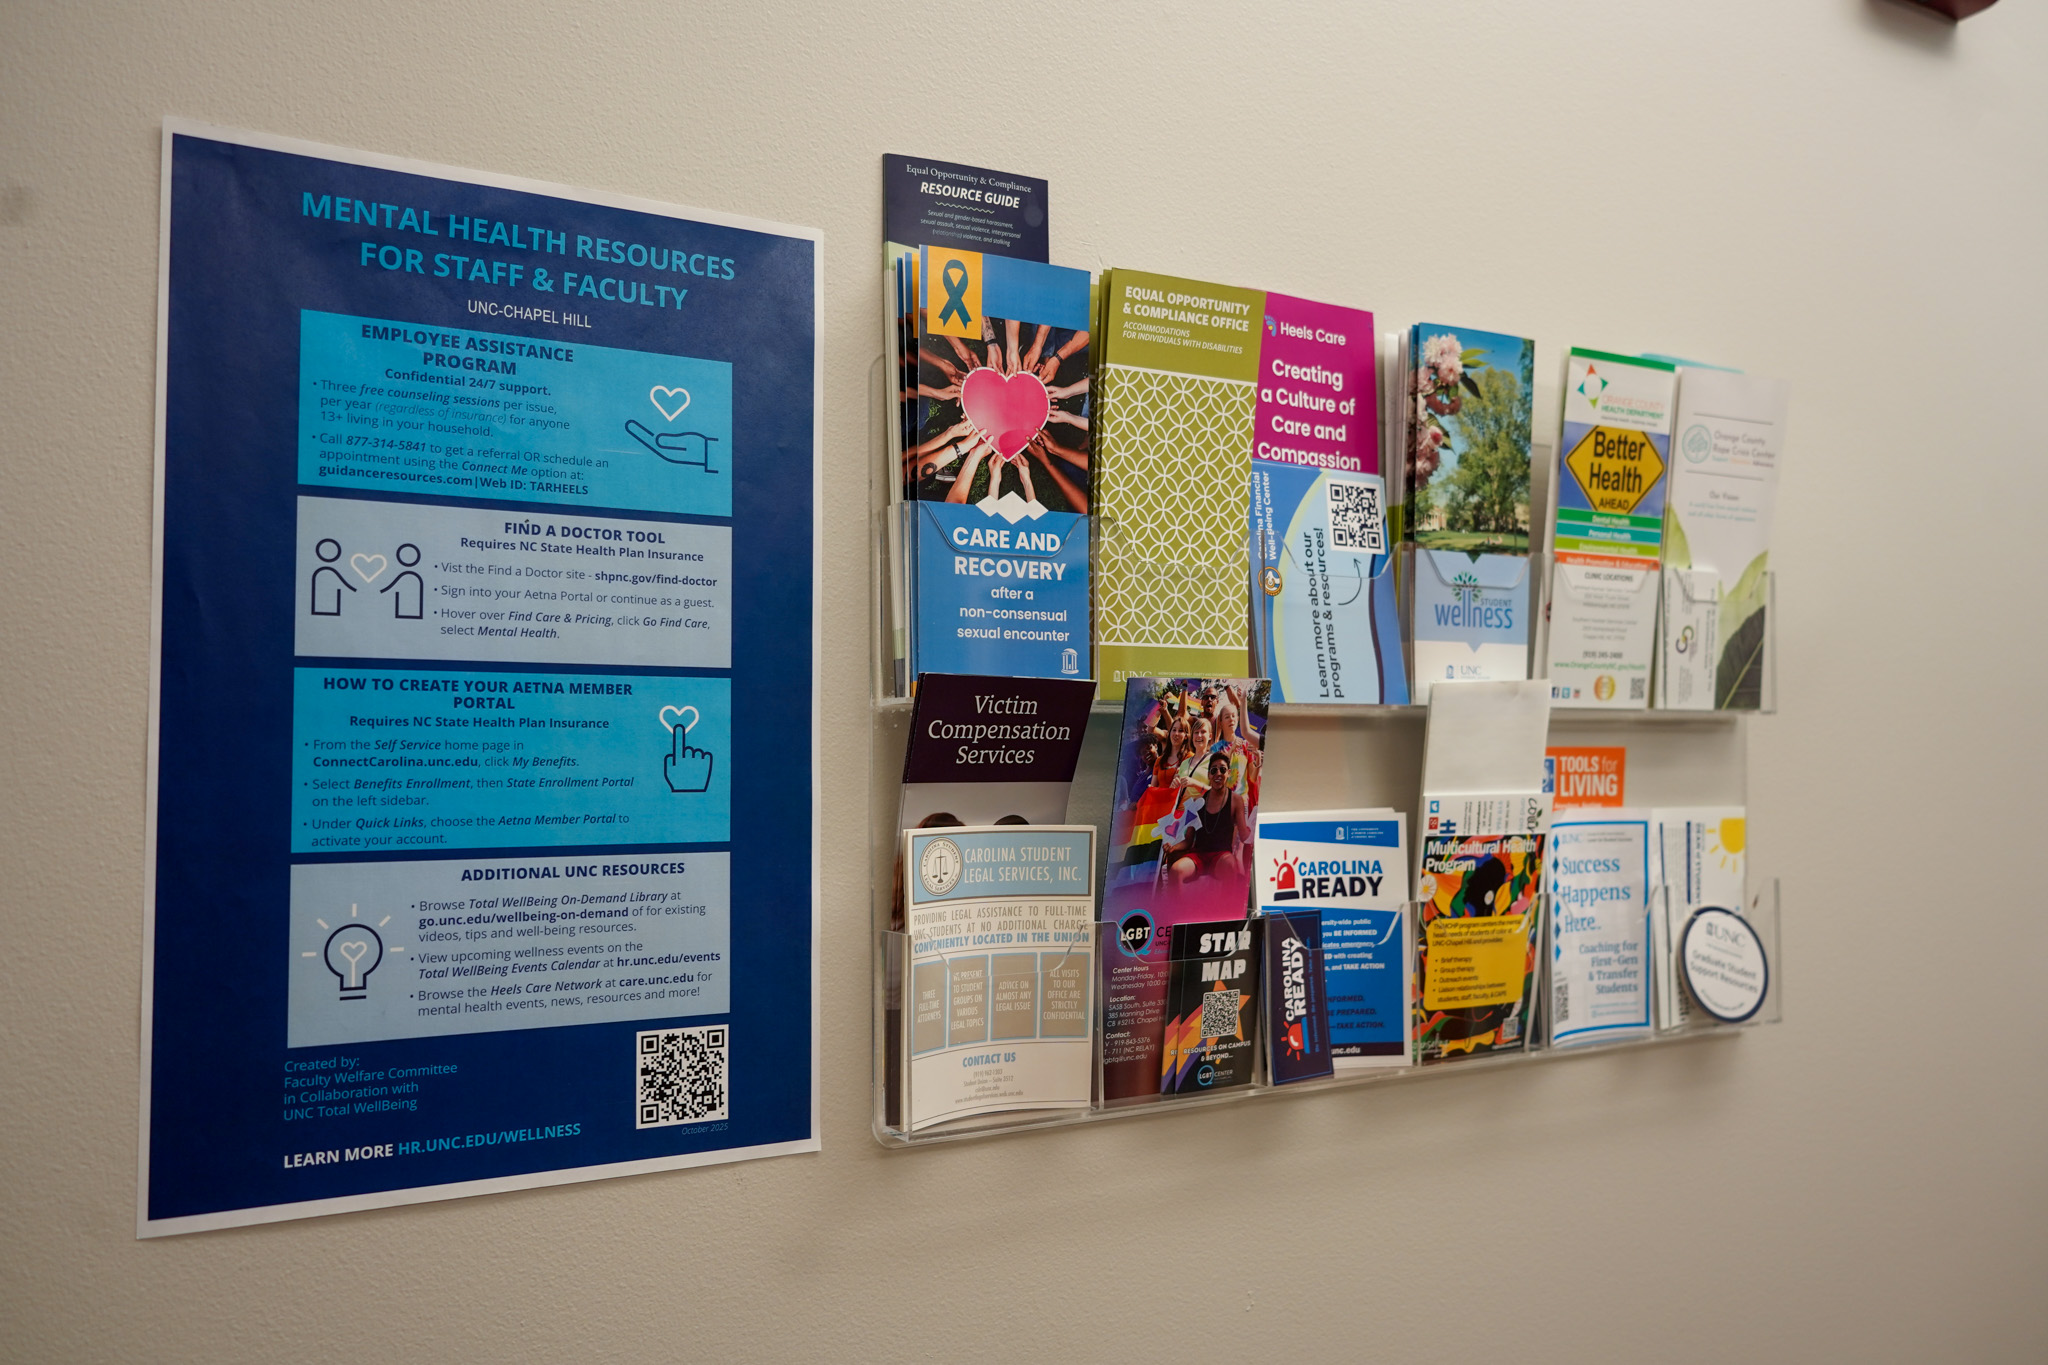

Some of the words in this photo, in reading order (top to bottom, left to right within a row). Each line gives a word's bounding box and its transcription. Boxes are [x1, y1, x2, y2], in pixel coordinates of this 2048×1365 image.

[907, 164, 928, 175] Equal
[930, 168, 978, 185] Opportunity
[989, 178, 1031, 193] Compliance
[921, 182, 982, 201] RESOURCE
[985, 192, 1020, 208] GUIDE
[954, 214, 985, 224] gender-based
[986, 219, 1013, 229] harassment,
[302, 191, 439, 236] MENTAL
[448, 214, 566, 255] HEALTH
[577, 234, 735, 281] RESOURCES
[360, 241, 425, 275] FOR
[434, 252, 524, 288] STAFF
[532, 268, 554, 292] &
[563, 272, 688, 310] FACULTY
[1125, 286, 1165, 303] EQUAL
[1167, 292, 1250, 315] OPPORTUNITY
[468, 300, 559, 324] UNC-CHAPEL
[563, 313, 591, 328] HILL
[1123, 303, 1131, 314] &
[1134, 304, 1209, 325] COMPLIANCE
[1211, 316, 1249, 332] OFFICE
[1123, 321, 1190, 338] ACCOMMODATIONS
[1280, 322, 1313, 341] Heels
[1315, 329, 1346, 346] Care
[361, 324, 460, 349] EMPLOYEE
[465, 336, 574, 363] ASSISTANCE
[1122, 330, 1136, 338] FOR
[1137, 332, 1181, 346] INDIVIDUALS
[1183, 338, 1201, 348] WITH
[1202, 341, 1242, 354] DISABILITIES
[423, 352, 517, 375] PROGRAM
[385, 368, 465, 387] Confidential
[468, 375, 497, 390] 24/7
[499, 381, 551, 397] support.
[1272, 360, 1343, 392] Creating
[1261, 390, 1272, 402] a
[1276, 388, 1335, 413] Culture
[1339, 398, 1355, 415] of
[1271, 416, 1311, 437] Care
[1314, 421, 1346, 442] and
[320, 433, 342, 444] Call
[346, 435, 426, 452] 877-314-5841
[430, 443, 442, 453] to
[445, 444, 464, 457] get
[467, 447, 474, 456] a
[477, 447, 520, 460] referral
[524, 451, 541, 462] OR
[543, 452, 593, 467] schedule
[596, 458, 608, 468] an
[1257, 442, 1361, 471] Compassion
[1594, 431, 1646, 461] Better
[510, 479, 527, 490] ID:
[530, 481, 588, 495] TARHEELS
[1262, 471, 1271, 505] Center
[1589, 462, 1642, 494] Health
[1253, 472, 1262, 516] Financial
[1599, 498, 1629, 511] AHEAD
[504, 521, 541, 537] FIND
[546, 526, 557, 538] A
[561, 526, 622, 542] DOCTOR
[627, 530, 666, 544] TOOL
[953, 527, 1010, 548] CARE
[1015, 532, 1061, 551] AND
[1265, 507, 1277, 560] Well-Being
[1303, 532, 1312, 557] our
[955, 556, 1066, 581] RECOVERY
[1313, 528, 1331, 606] resources!
[595, 571, 717, 587] shpnc.gov/find-doctor
[1304, 561, 1319, 606] about
[991, 587, 1022, 599] after
[1025, 591, 1034, 600] a
[1480, 598, 1512, 606] STUDENT
[960, 607, 1067, 622] non-consensual
[1323, 610, 1332, 620] &
[1434, 590, 1512, 628] wellness
[957, 627, 1000, 639] sexual
[1004, 630, 1069, 642] encounter
[1311, 610, 1324, 650] more
[1323, 624, 1344, 698] programs
[1460, 665, 1482, 675] UNC
[323, 677, 366, 691] HOW
[371, 678, 394, 692] TO
[399, 678, 459, 692] CREATE
[464, 680, 508, 693] YOUR
[512, 681, 564, 695] AETNA
[568, 682, 633, 695] MEMBER
[1318, 654, 1329, 698] Learn
[453, 697, 515, 710] PORTAL
[975, 695, 1038, 715] Victim
[928, 719, 1070, 744] Compensation
[956, 745, 1035, 764] Services
[1560, 756, 1599, 772] TOOLS
[1602, 756, 1618, 771] for
[1560, 774, 1618, 797] LIVING
[965, 848, 1015, 863] CAROLINA
[1020, 847, 1071, 862] STUDENT
[1427, 840, 1500, 855] Multicultural
[1502, 840, 1536, 853] Health
[461, 866, 560, 882] ADDITIONAL
[565, 864, 597, 878] UNC
[602, 861, 685, 877] RESOURCES
[964, 867, 994, 883] LEGAL
[999, 867, 1053, 884] SERVICES,
[1059, 867, 1081, 880] INC.
[1298, 860, 1383, 876] CAROLINA
[1425, 858, 1476, 874] Program
[1562, 857, 1620, 875] Success
[1302, 876, 1383, 899] READY
[1562, 886, 1631, 907] Happens
[1121, 927, 1151, 941] LGBT
[1199, 931, 1251, 953] STAR
[1715, 924, 1746, 947] UNC
[1579, 942, 1620, 954] Coaching
[1622, 941, 1639, 952] for
[1201, 959, 1246, 982] MAP
[1591, 955, 1638, 967] First-Gen
[1282, 938, 1294, 1021] CAROLINA
[1290, 938, 1306, 1016] READY
[1596, 970, 1638, 981] Transfer
[1596, 982, 1638, 994] Students
[1184, 1045, 1217, 1054] RESOURCES
[1228, 1040, 1251, 1048] CAMPUS
[284, 1057, 336, 1073] Created
[340, 1055, 360, 1069] by:
[963, 1053, 1001, 1067] CONTACT
[1004, 1052, 1016, 1062] US
[284, 1073, 331, 1089] Faculty
[334, 1069, 385, 1085] Welfare
[388, 1062, 458, 1079] Committee
[284, 1094, 296, 1104] in
[300, 1086, 388, 1103] Collaboration
[391, 1082, 419, 1094] with
[284, 1106, 314, 1121] UNC
[317, 1103, 350, 1118] Total
[354, 1097, 418, 1114] WellBeing
[682, 1125, 708, 1135] October
[710, 1123, 728, 1132] 2025
[283, 1150, 340, 1169] LEARN
[344, 1143, 393, 1162] MORE
[399, 1123, 581, 1157] HR.UNC.EDU/WELLNESS
